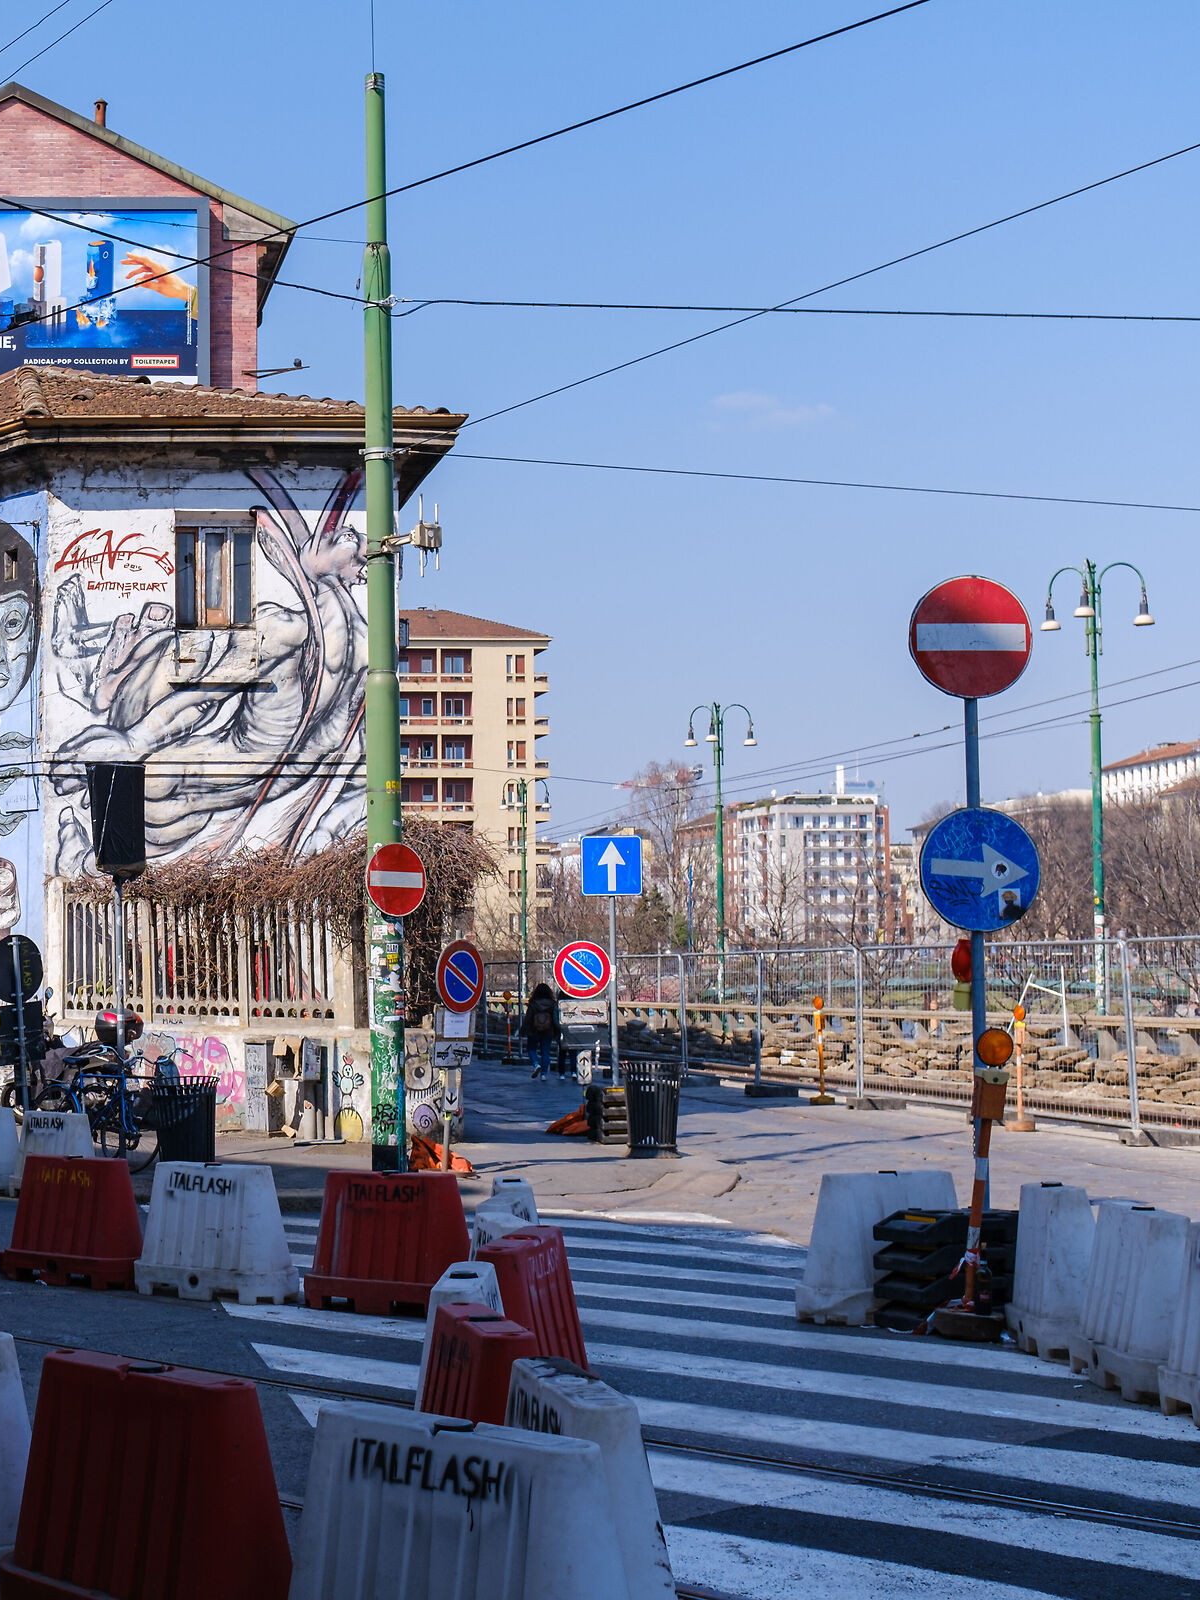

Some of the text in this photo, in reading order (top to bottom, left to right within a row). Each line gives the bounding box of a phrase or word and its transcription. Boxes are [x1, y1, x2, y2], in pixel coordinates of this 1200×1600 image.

[30, 1117, 64, 1131] ITALFLASH
[169, 1171, 232, 1195] ITALFLASH
[347, 1182, 422, 1204] ITALFLASH
[350, 1437, 505, 1503] ITALFLASH
